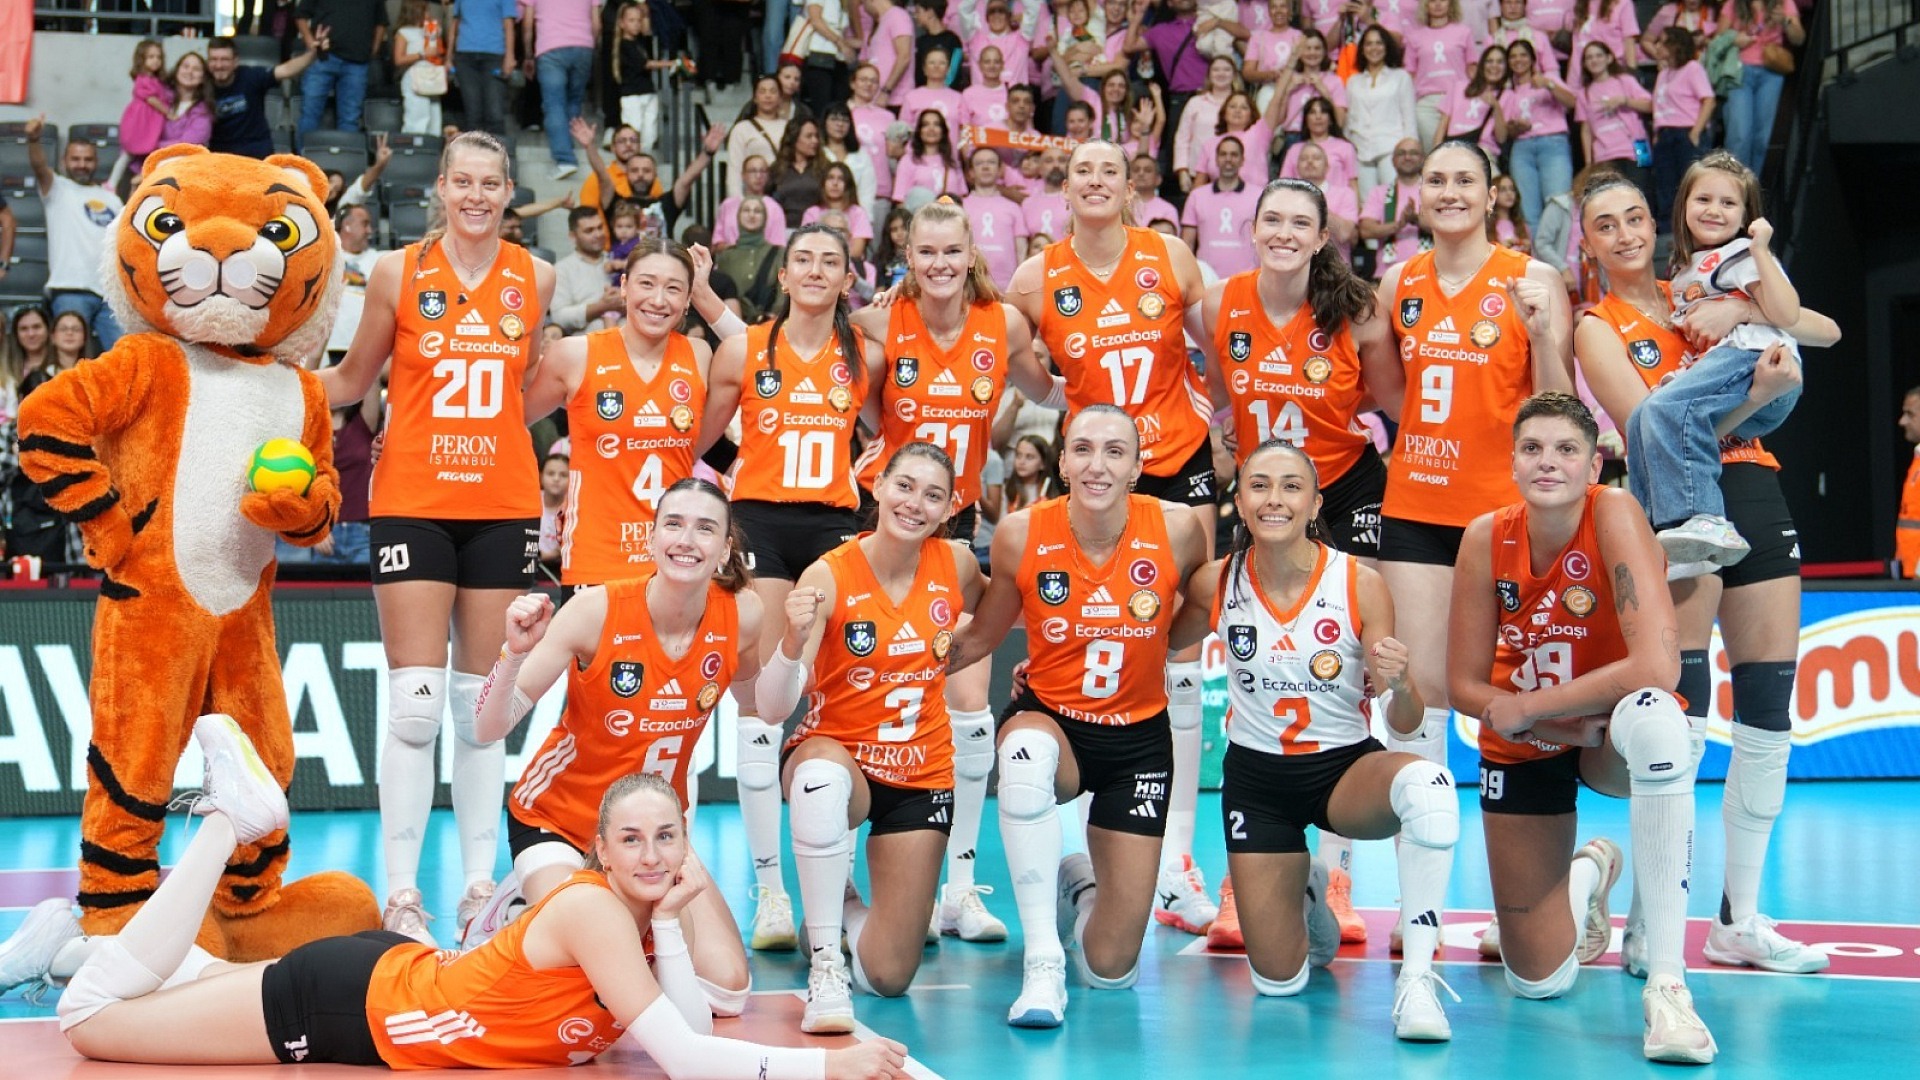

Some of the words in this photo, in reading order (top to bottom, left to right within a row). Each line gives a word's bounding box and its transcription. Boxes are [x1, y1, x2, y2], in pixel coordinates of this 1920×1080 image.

[432, 359, 504, 418] 20
[1100, 346, 1154, 406] 17
[1421, 364, 1454, 424] 9
[1247, 399, 1310, 448] 14
[432, 434, 498, 455] PERON
[778, 430, 835, 488] 10
[1405, 433, 1460, 459] PERON
[437, 471, 484, 483] PEGASUS
[632, 453, 667, 510] 4
[1408, 471, 1450, 486] PEGASUS
[1354, 513, 1381, 525] HDI
[378, 543, 411, 574] 20
[1082, 639, 1124, 698] 8
[878, 687, 924, 742] 3
[1273, 697, 1321, 756] 2
[855, 742, 927, 767] PERON
[1135, 780, 1166, 795] HDI
[1229, 810, 1248, 840] 2
